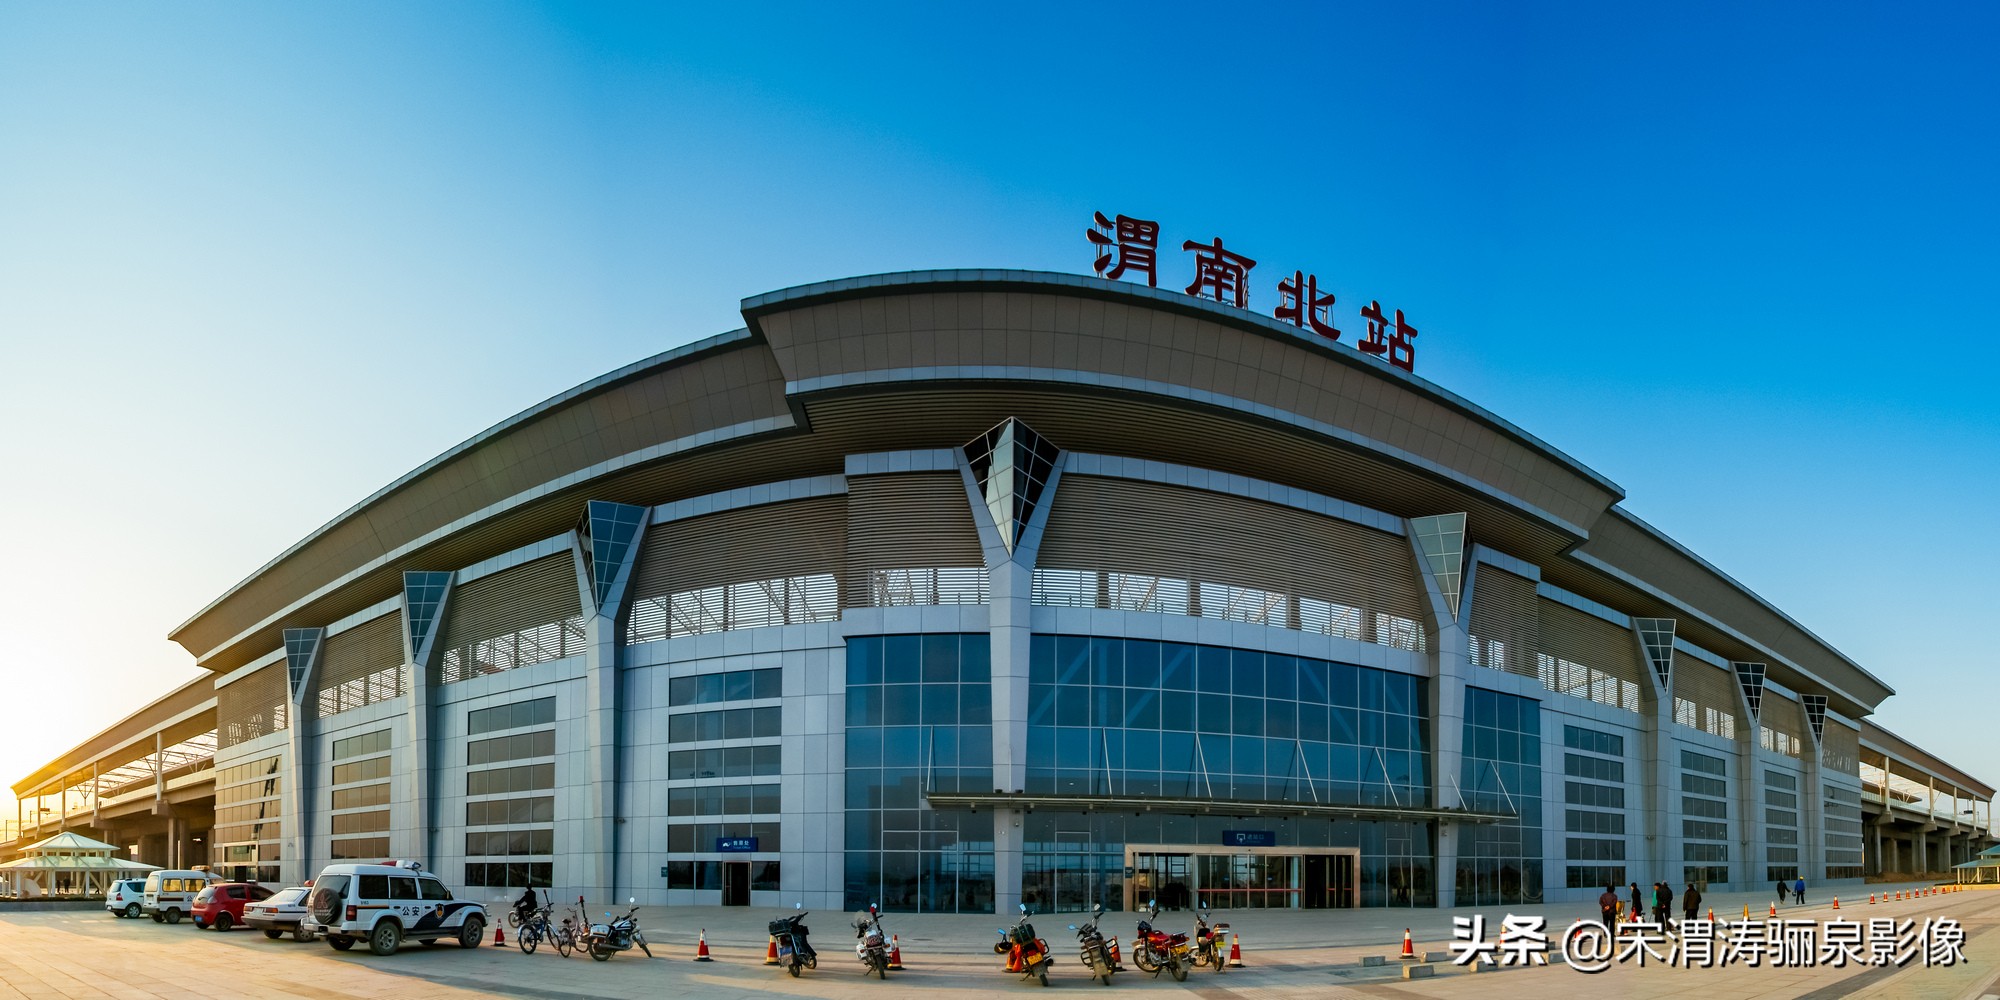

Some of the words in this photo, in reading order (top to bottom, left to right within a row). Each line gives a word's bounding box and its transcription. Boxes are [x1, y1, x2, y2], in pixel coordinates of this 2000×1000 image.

[1086, 211, 1418, 373] 渭南北站
[402, 906, 420, 916] 公安
